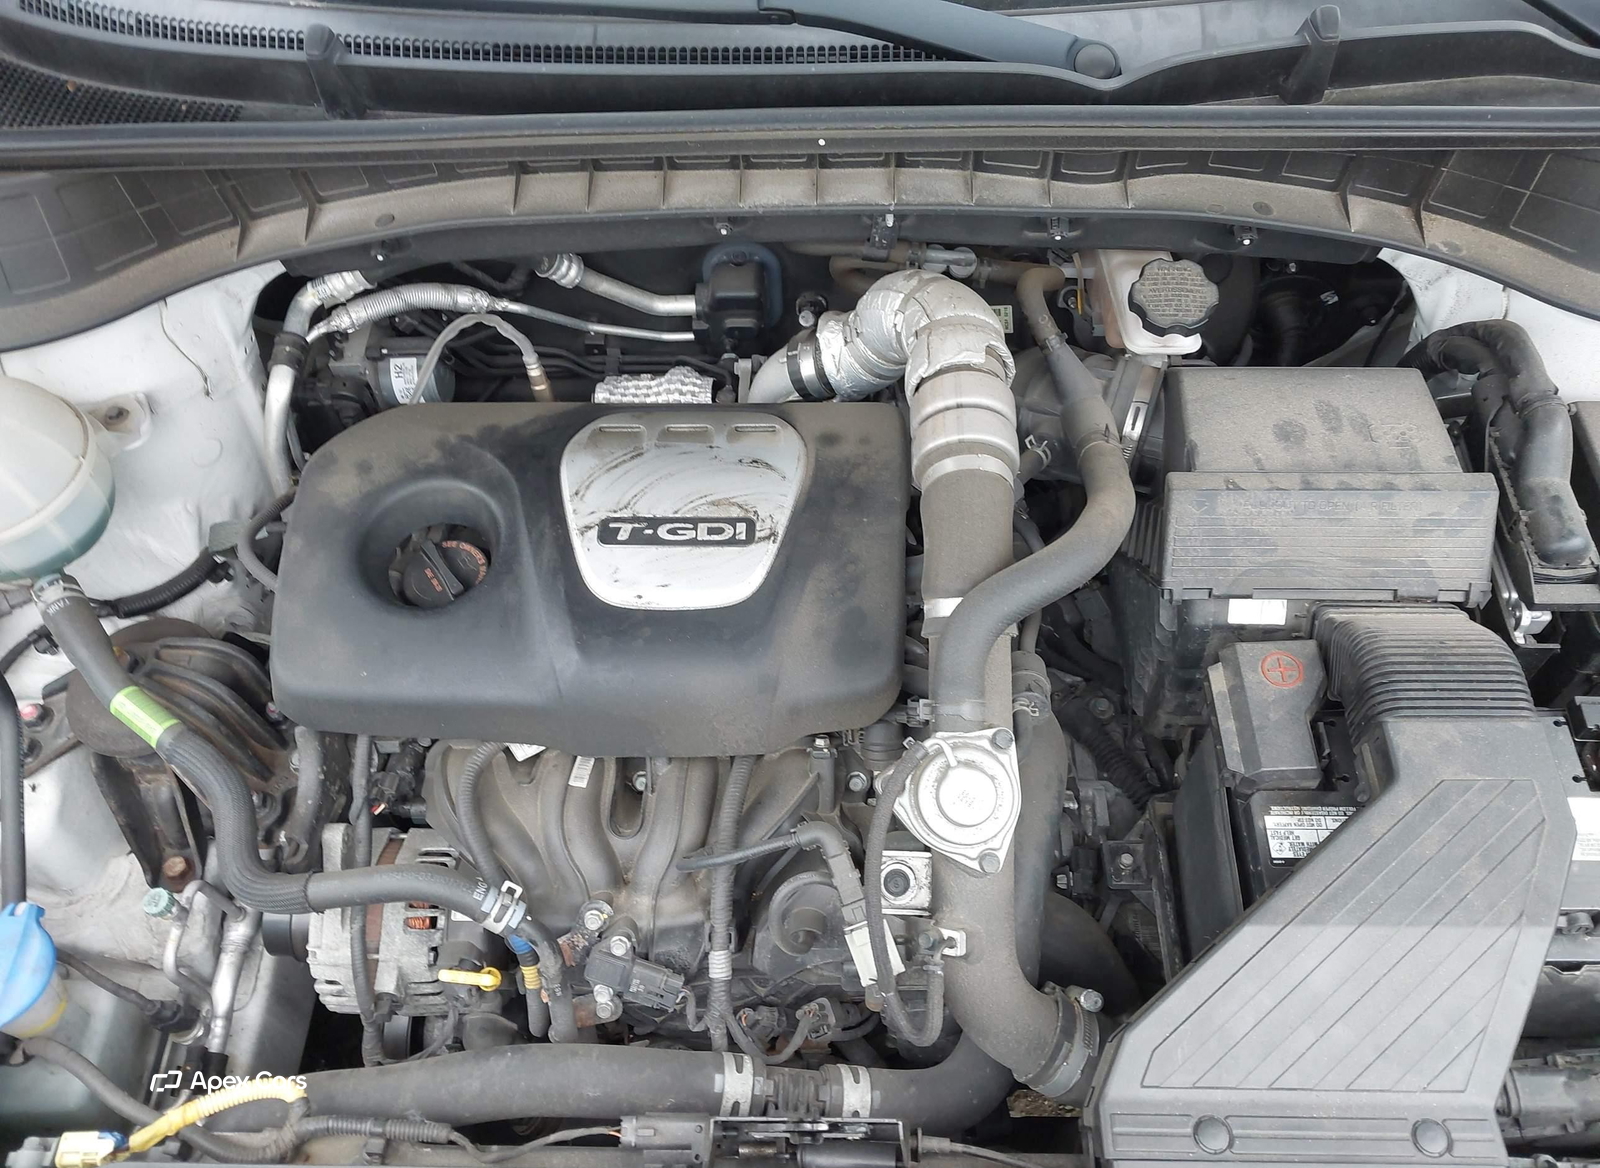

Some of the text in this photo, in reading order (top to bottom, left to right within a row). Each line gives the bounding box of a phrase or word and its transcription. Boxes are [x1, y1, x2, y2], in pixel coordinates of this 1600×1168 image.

[394, 363, 403, 379] H2
[1318, 501, 1350, 511] OPEN
[608, 522, 747, 541] T-GDI
